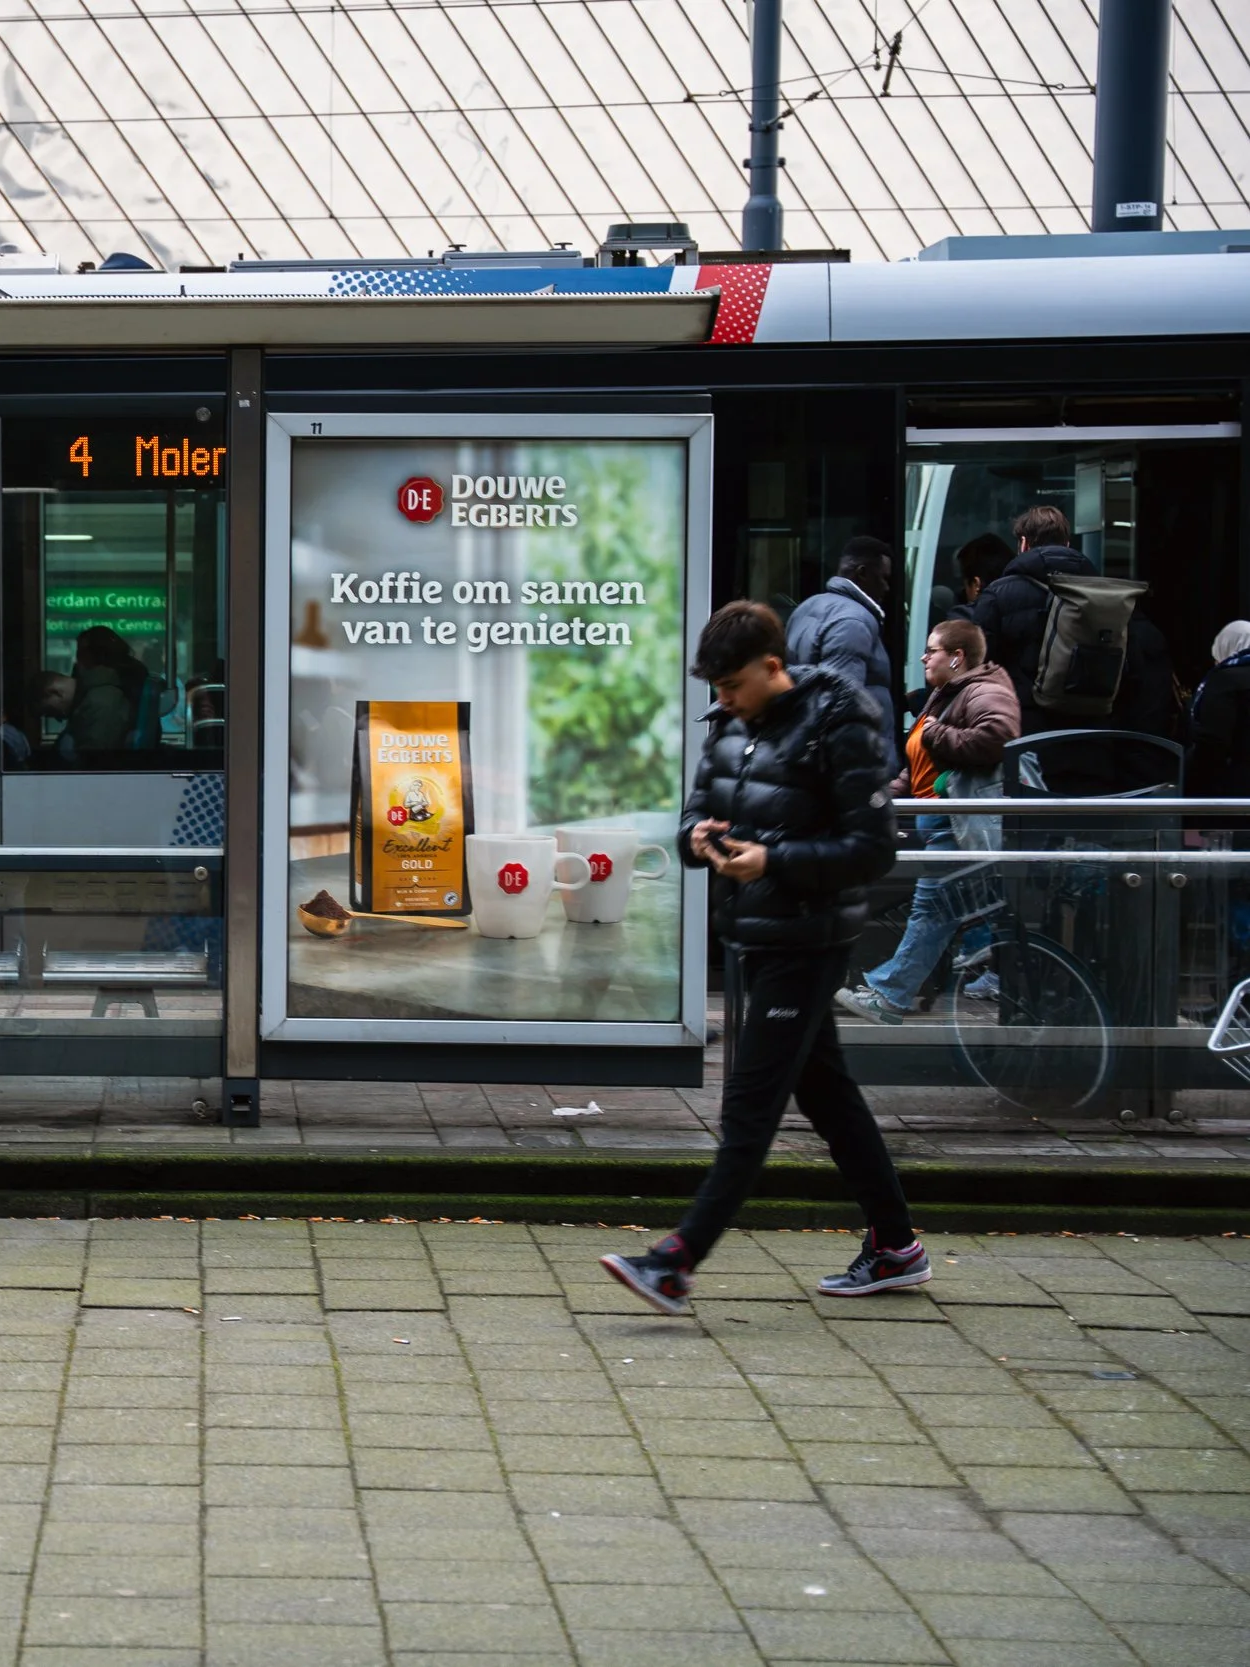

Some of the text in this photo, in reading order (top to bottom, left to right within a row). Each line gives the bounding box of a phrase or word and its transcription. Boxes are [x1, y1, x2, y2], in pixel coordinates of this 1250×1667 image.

[69, 436, 93, 477] 4
[451, 502, 578, 527] EGBERTS
[330, 571, 646, 605] Koffie om samen
[342, 613, 632, 653] van te genieten
[378, 748, 453, 763] EGBERTS
[382, 837, 453, 854] Excellent
[401, 859, 433, 870] GOLD
